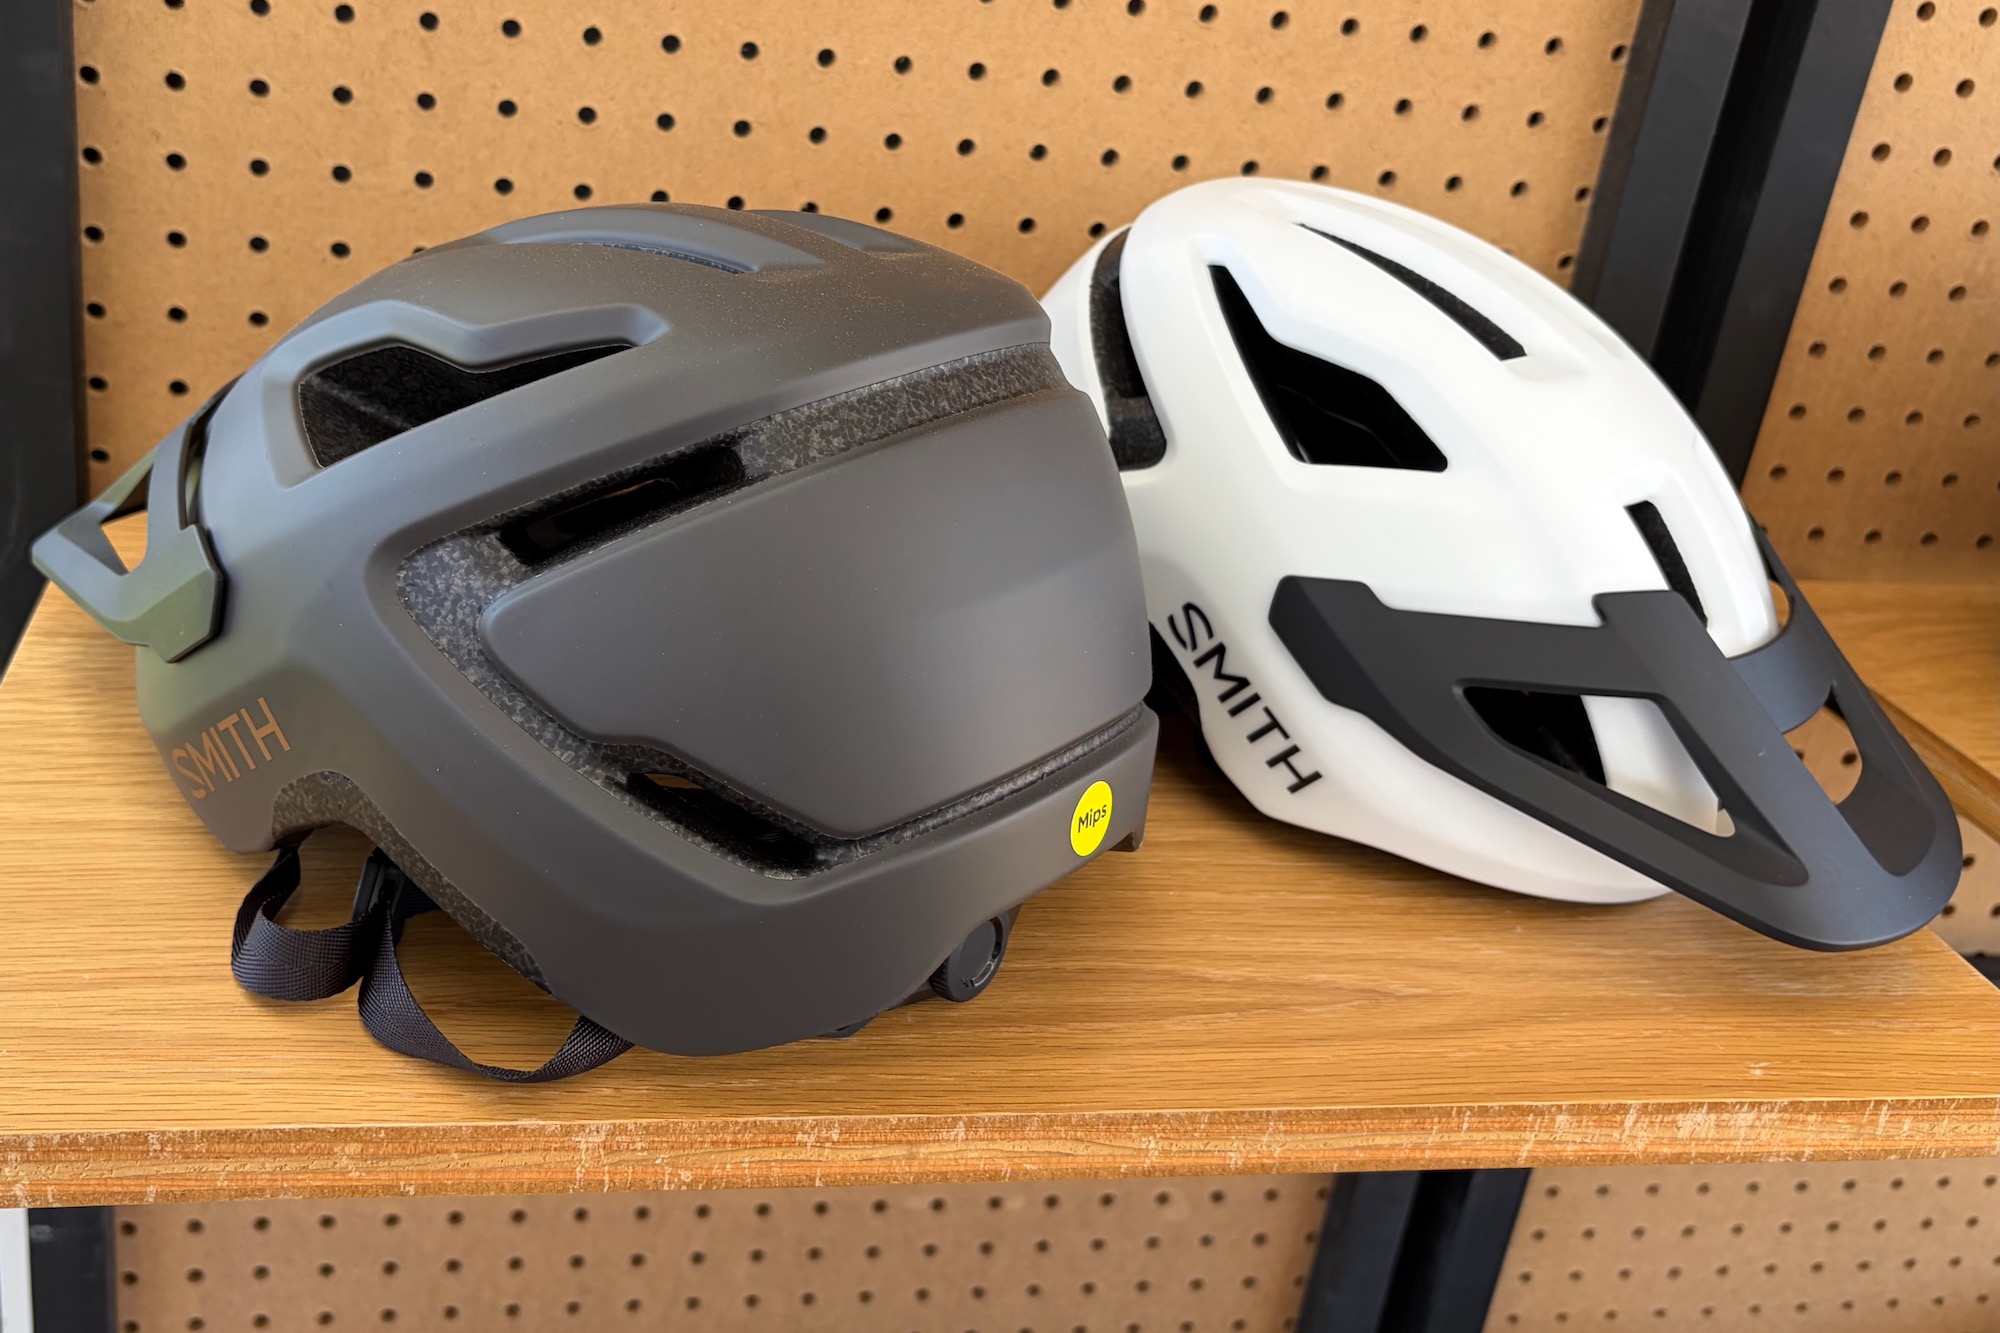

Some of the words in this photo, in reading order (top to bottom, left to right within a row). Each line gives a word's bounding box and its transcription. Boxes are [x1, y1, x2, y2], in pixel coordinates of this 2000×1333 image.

[172, 697, 291, 799] SMITH
[1168, 602, 1322, 794] SMITH
[1078, 804, 1107, 833] Mips
